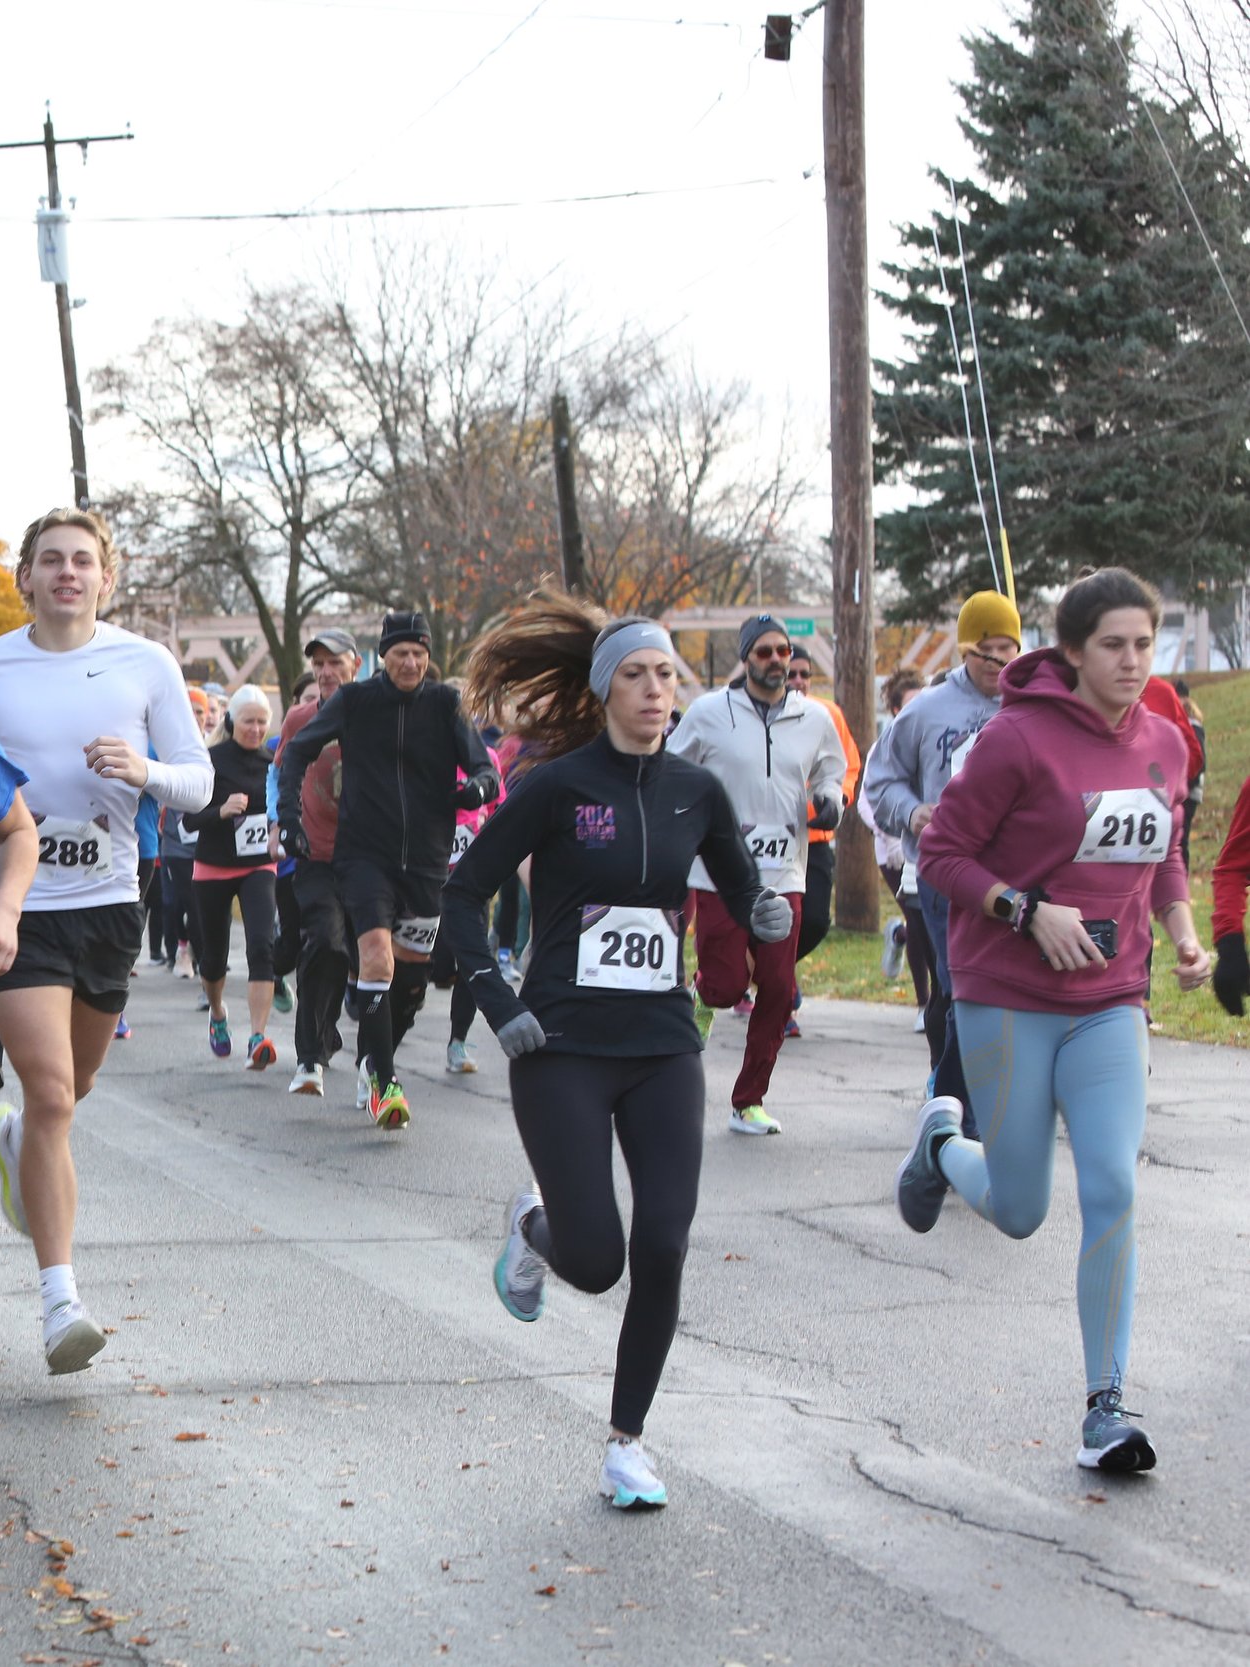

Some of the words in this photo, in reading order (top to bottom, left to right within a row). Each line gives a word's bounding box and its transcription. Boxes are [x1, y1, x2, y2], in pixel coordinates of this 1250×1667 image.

[575, 805, 615, 826] 2014
[1097, 812, 1157, 847] 216
[38, 836, 99, 867] 288
[751, 838, 789, 858] 247
[599, 930, 664, 970] 280
